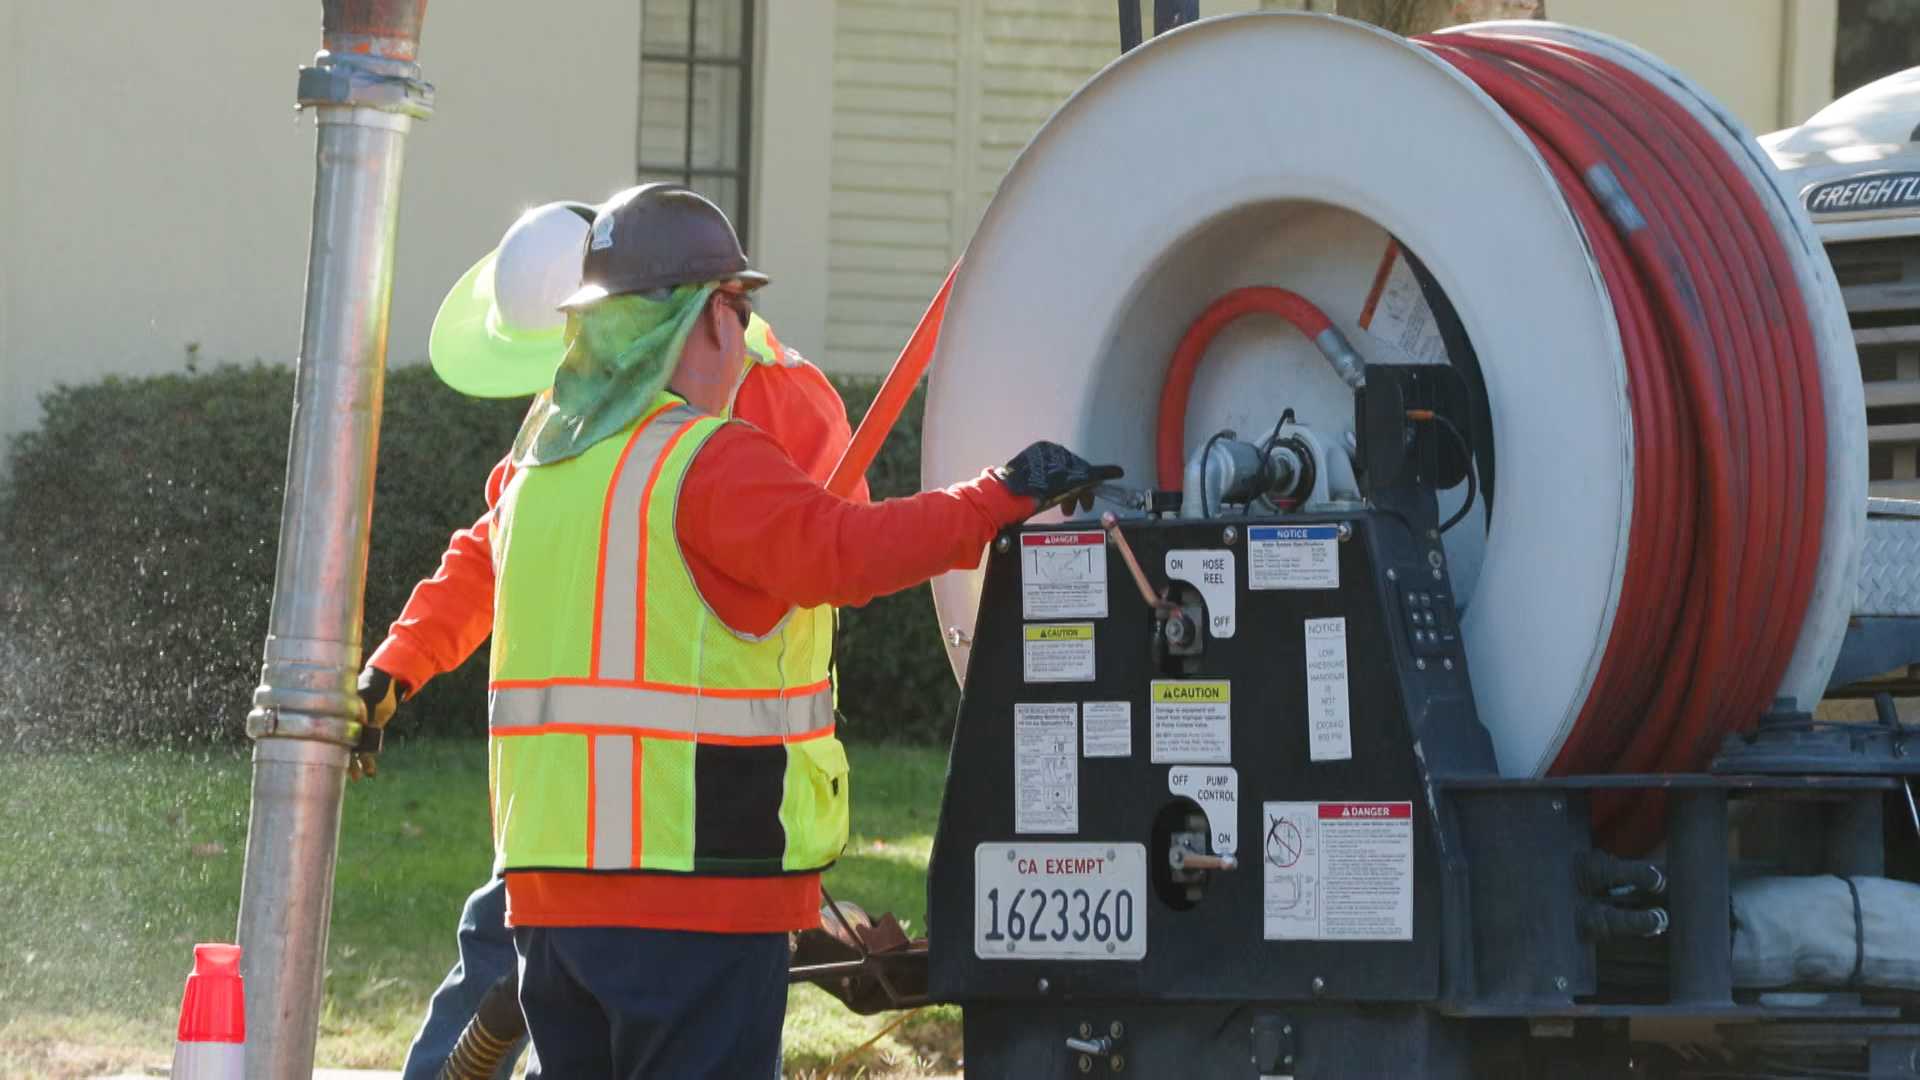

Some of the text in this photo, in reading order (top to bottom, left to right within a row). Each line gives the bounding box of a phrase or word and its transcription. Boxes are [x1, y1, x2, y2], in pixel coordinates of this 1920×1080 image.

[1277, 529, 1309, 538] NOTICE
[1050, 535, 1079, 544] DANGER
[1170, 559, 1184, 570] ON
[1202, 559, 1225, 570] HOSE
[1203, 573, 1225, 584] REEL
[1213, 616, 1231, 627] OFF
[1047, 629, 1079, 638] CAUTION
[1308, 623, 1341, 634] NOTICE
[1173, 687, 1220, 698] CAUTION
[1172, 775, 1189, 786] OFF
[1206, 775, 1229, 786] PUMP
[1197, 790, 1235, 801] CONTROL
[1351, 807, 1390, 817] DANGER
[1218, 833, 1231, 844] ON
[1018, 858, 1105, 874] CA EXEMPT
[985, 887, 1133, 942] 1623360
